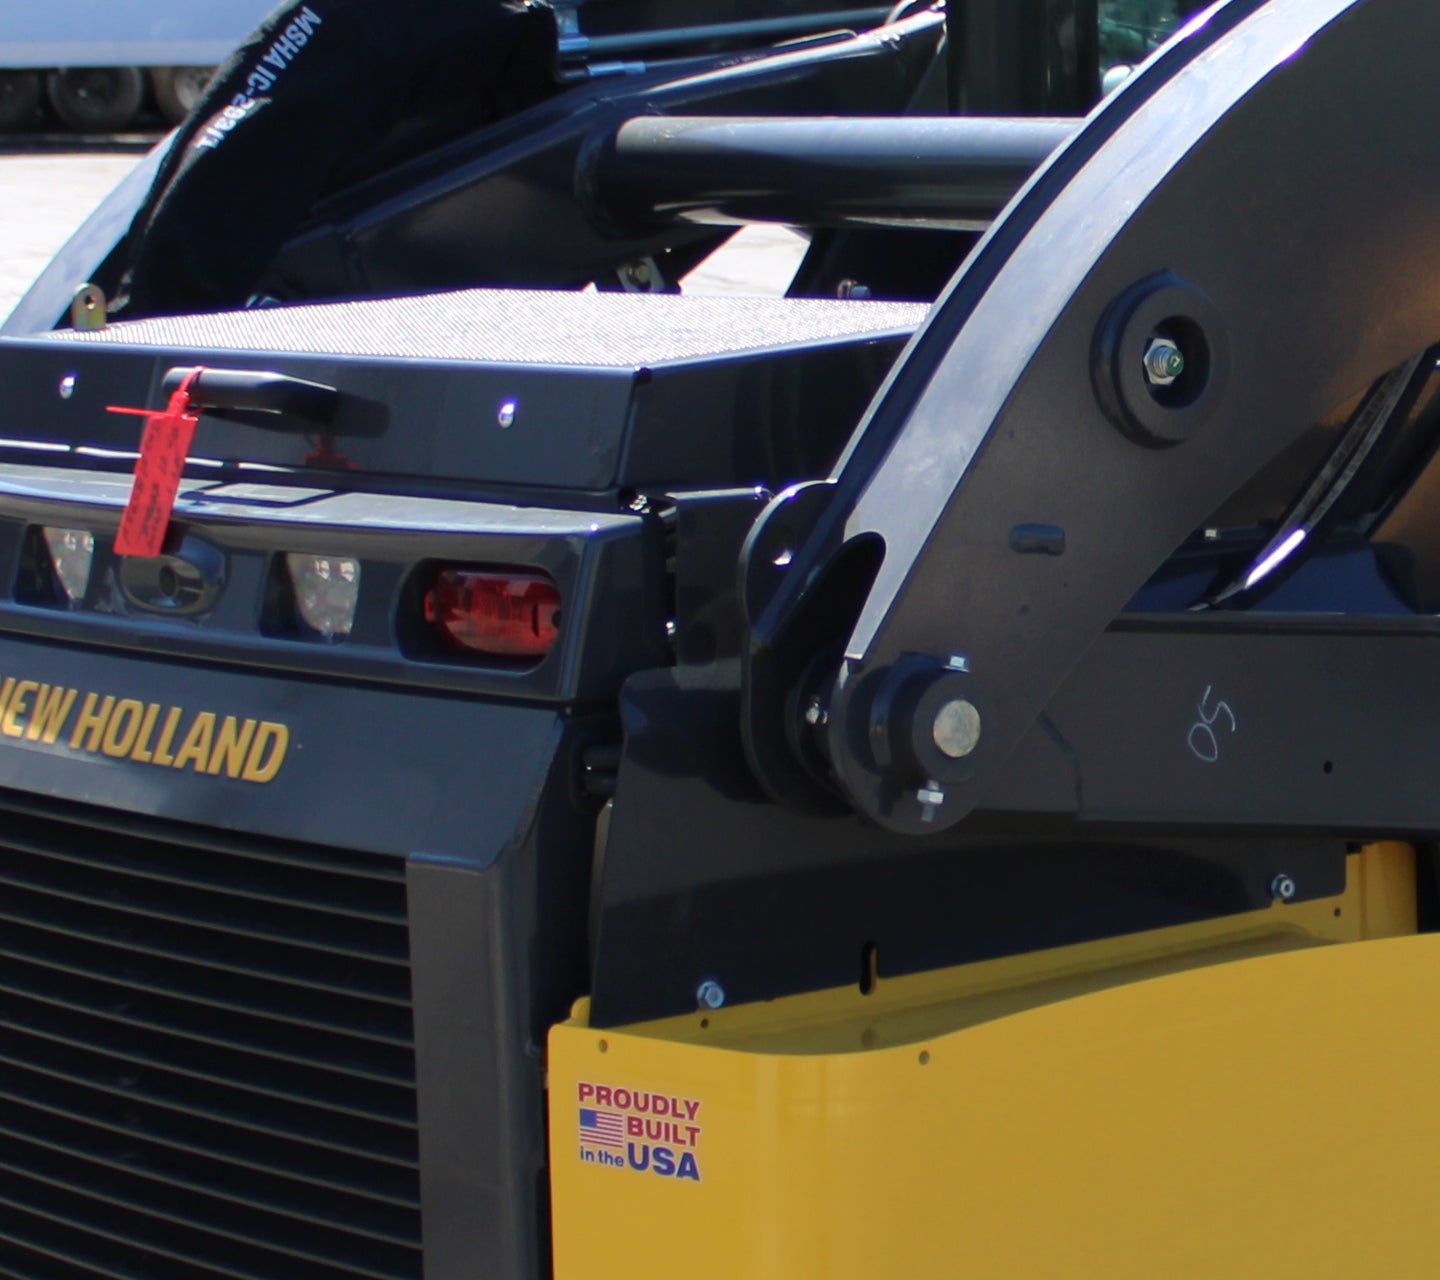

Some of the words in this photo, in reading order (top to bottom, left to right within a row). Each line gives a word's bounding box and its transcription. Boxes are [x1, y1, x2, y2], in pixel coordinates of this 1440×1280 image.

[263, 6, 322, 69] MSHA
[68, 694, 290, 784] HOLLAND
[577, 1082, 701, 1121] PROUDLY
[626, 1116, 701, 1147] BUILT
[579, 1146, 595, 1162] in
[597, 1150, 625, 1167] the
[626, 1142, 702, 1182] USA
